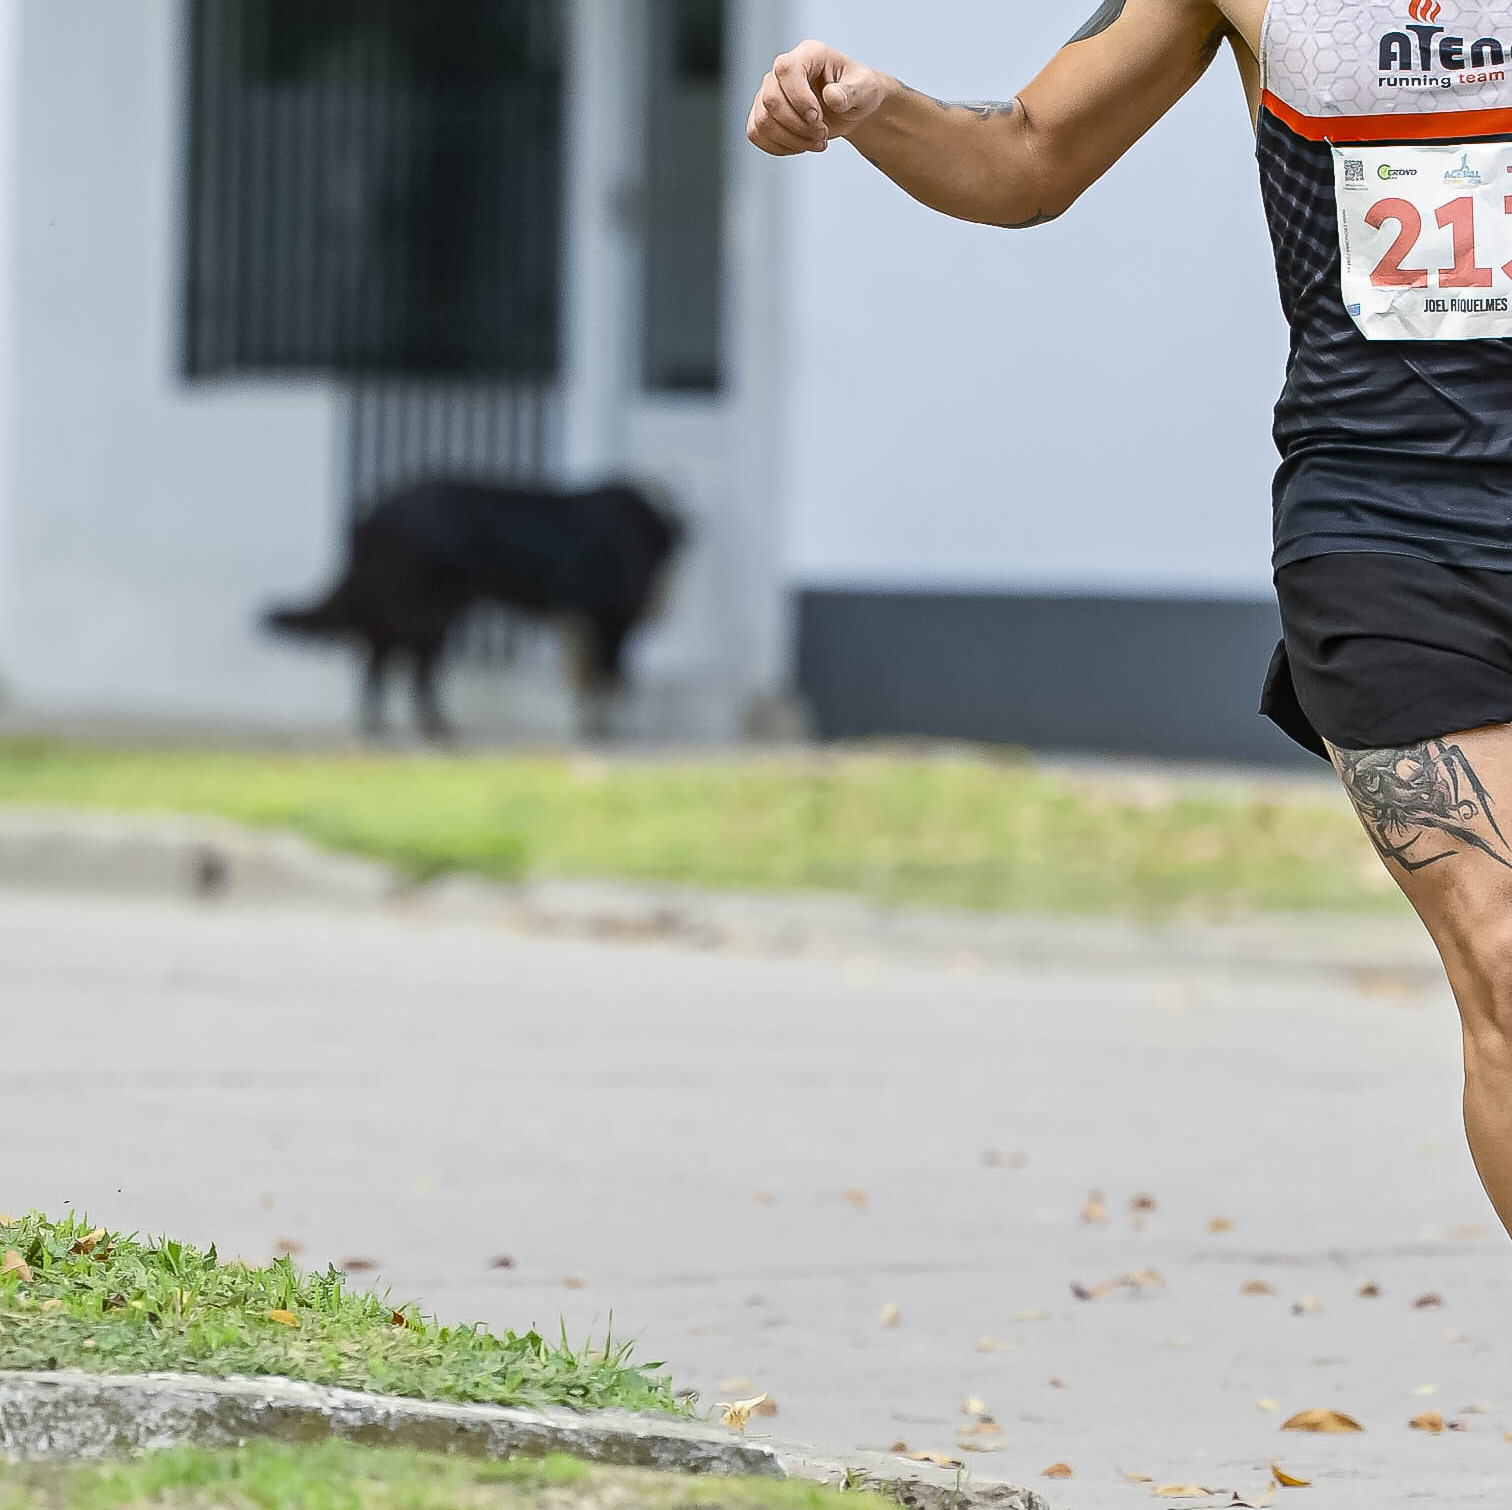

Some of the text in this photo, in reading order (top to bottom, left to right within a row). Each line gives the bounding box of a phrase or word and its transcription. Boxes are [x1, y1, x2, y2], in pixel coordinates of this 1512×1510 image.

[1378, 70, 1505, 88] running team
[1424, 298, 1508, 313] JOEL RIQUELMES
